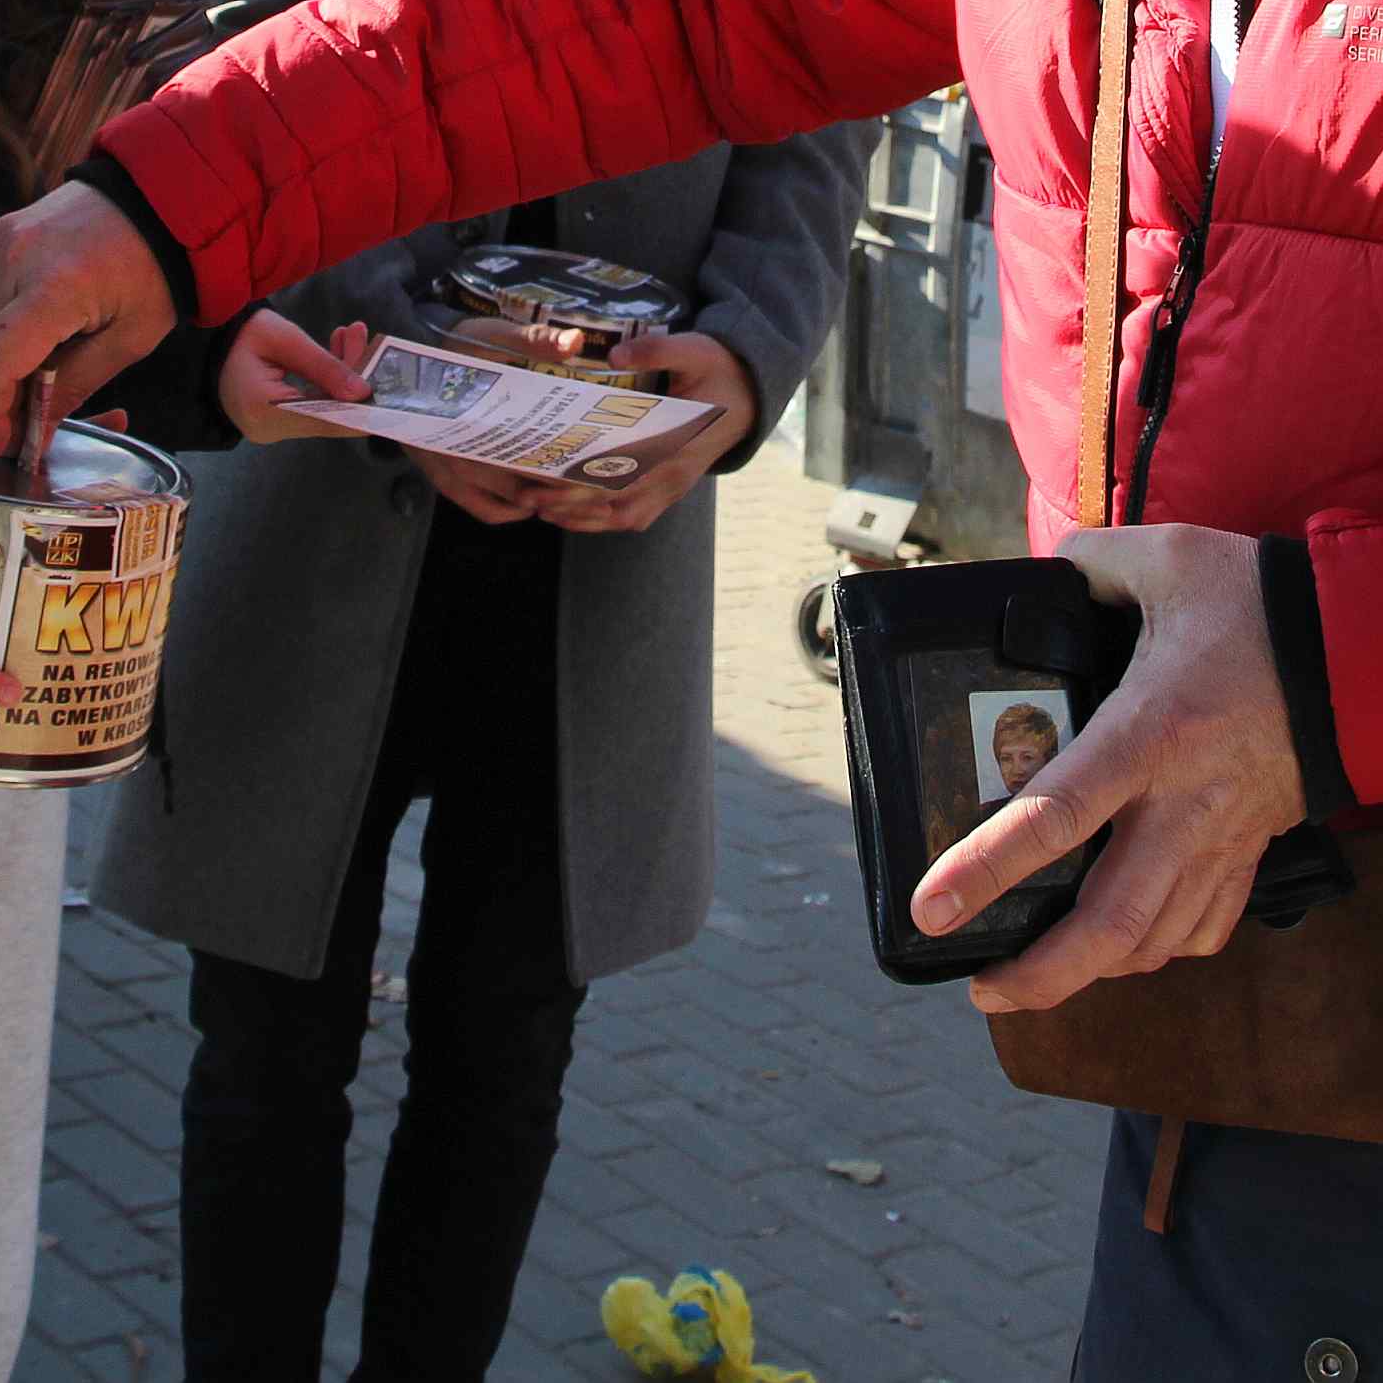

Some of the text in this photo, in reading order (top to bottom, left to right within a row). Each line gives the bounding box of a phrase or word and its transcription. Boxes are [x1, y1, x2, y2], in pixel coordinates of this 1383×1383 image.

[42, 665, 76, 681] NA
[5, 708, 40, 726] NA
[77, 729, 98, 746] W
